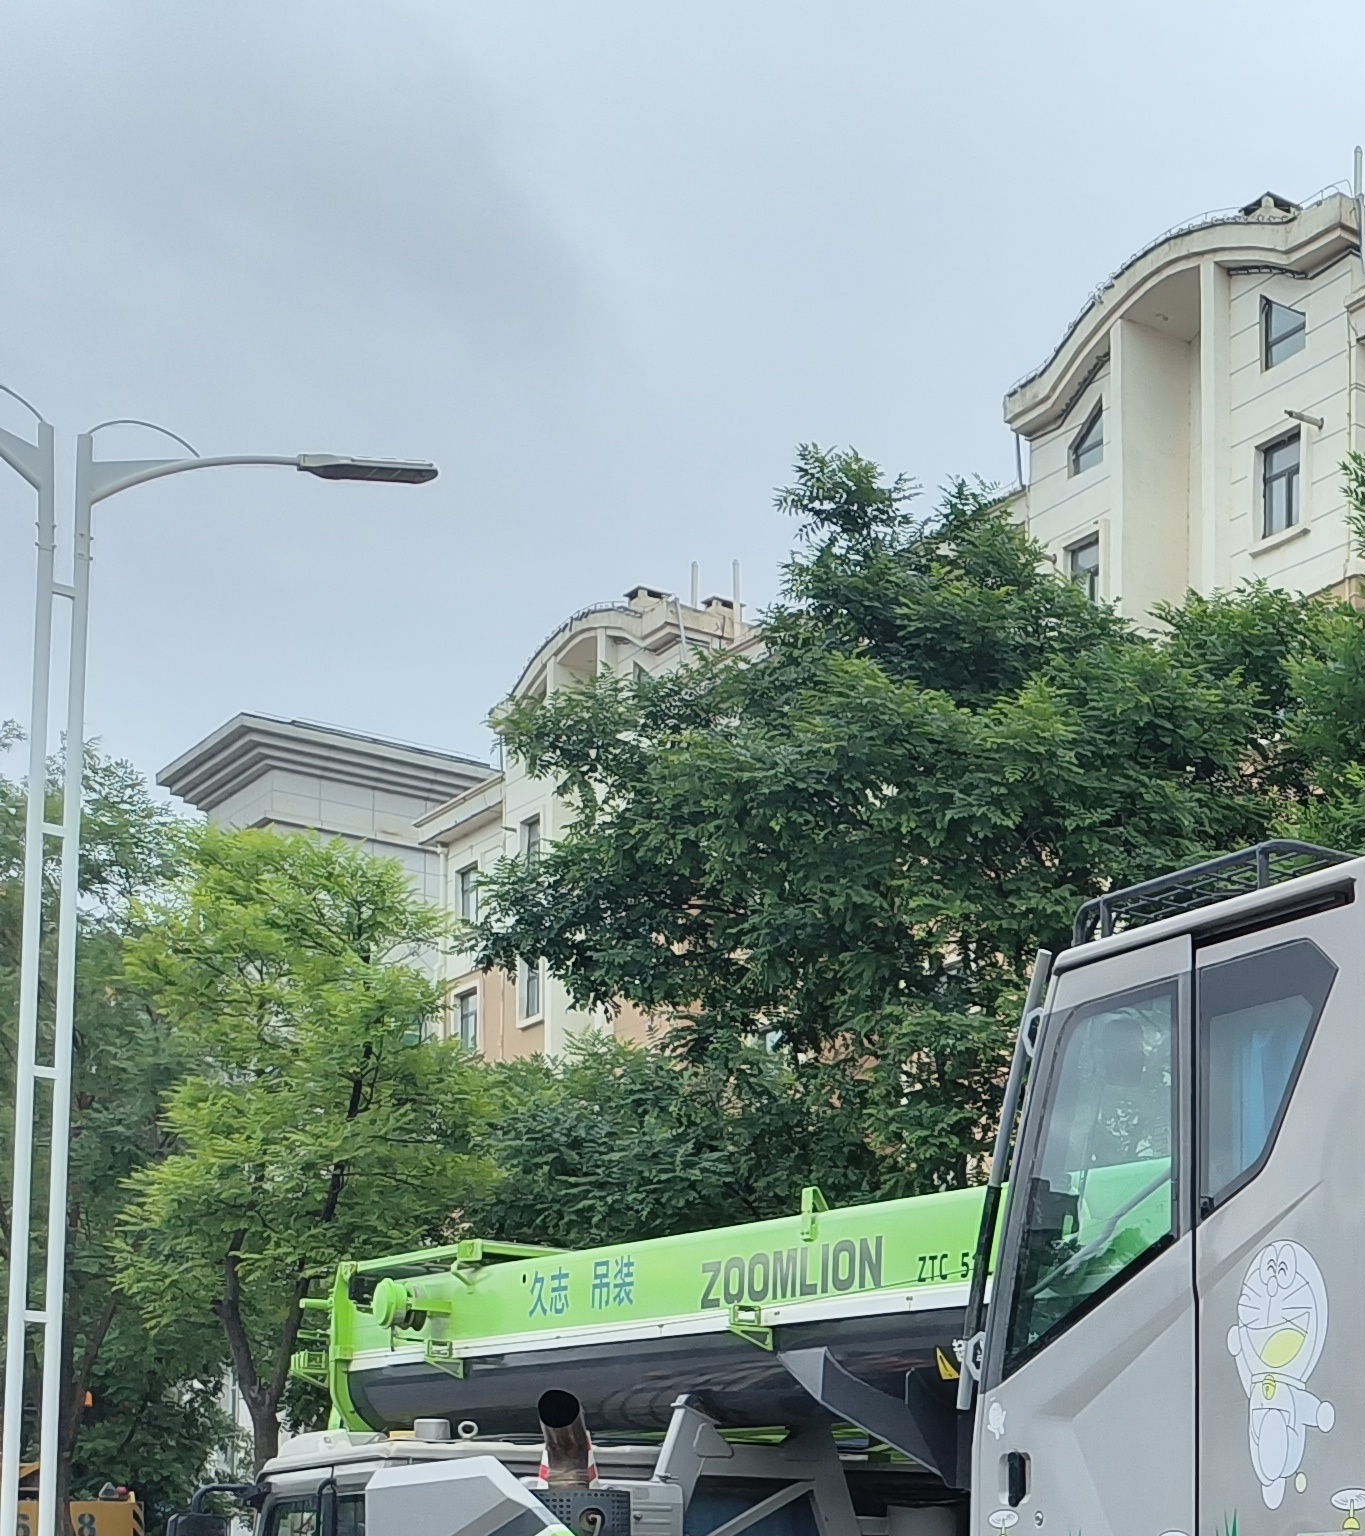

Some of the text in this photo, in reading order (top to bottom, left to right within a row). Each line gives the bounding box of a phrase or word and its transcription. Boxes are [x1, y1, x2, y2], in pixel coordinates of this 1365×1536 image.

[528, 1255, 635, 1318] 久志 吊装
[701, 1236, 884, 1309] ZOOMLION
[917, 1253, 949, 1283] ZTC
